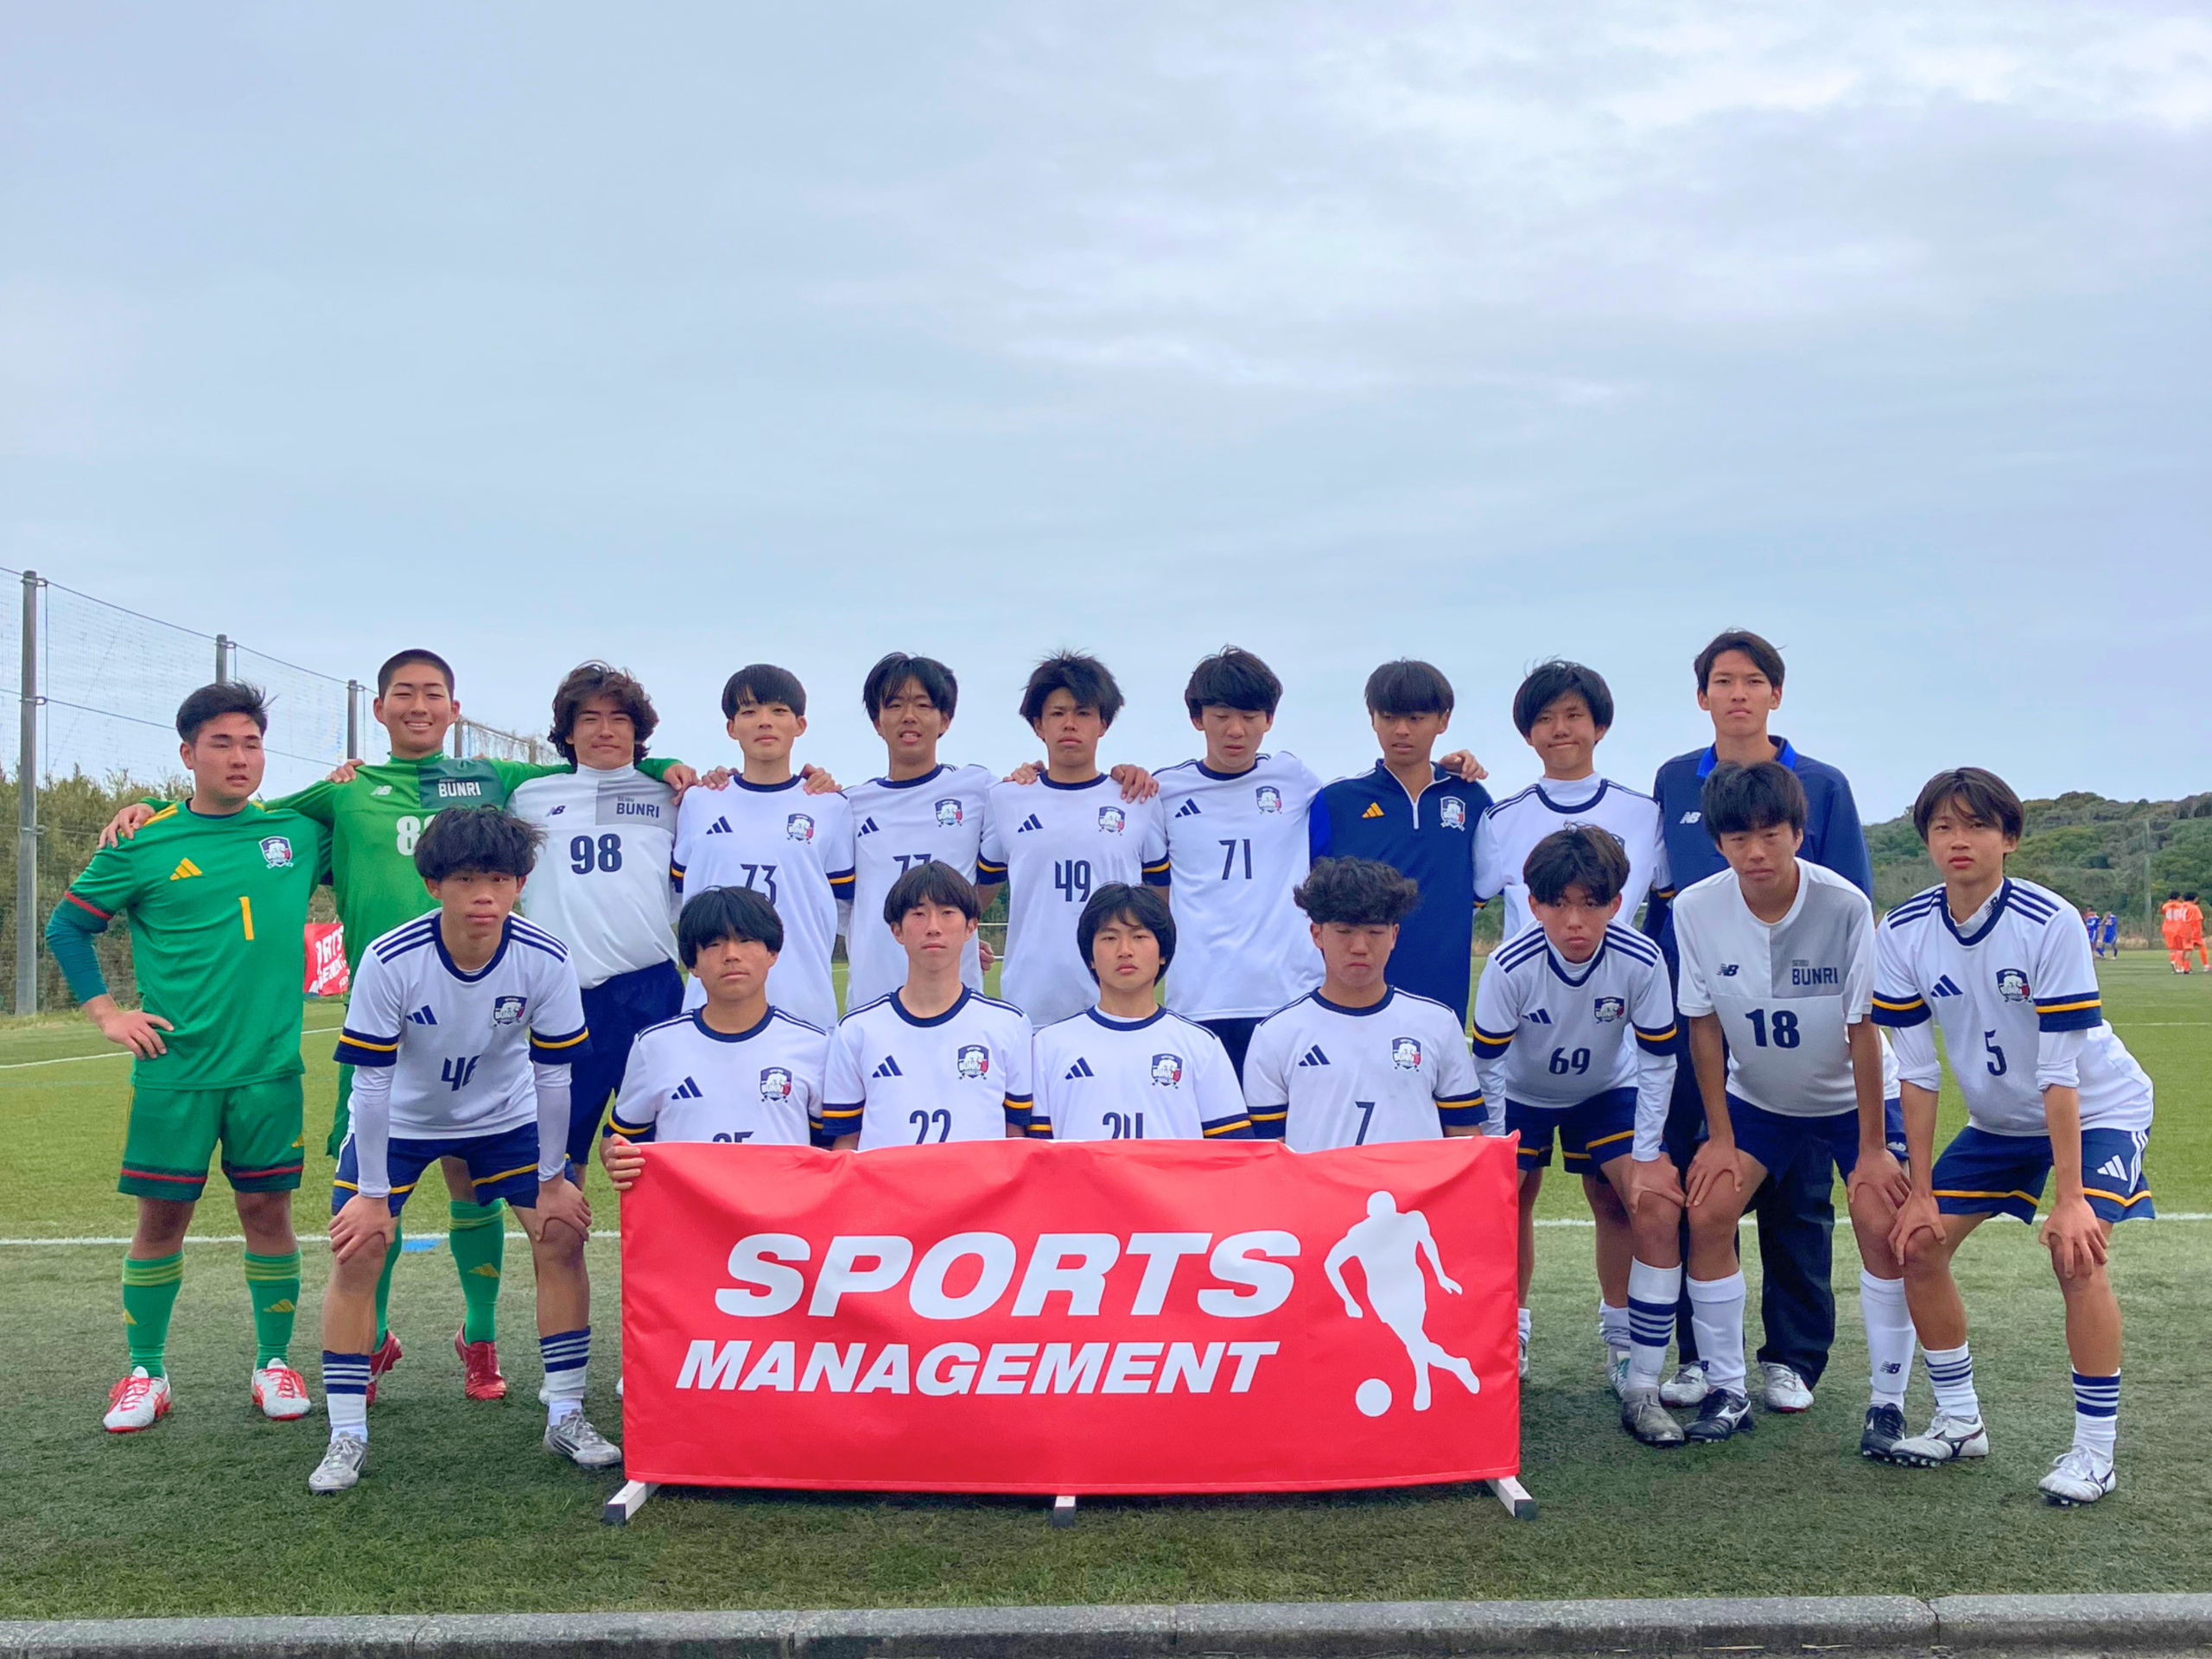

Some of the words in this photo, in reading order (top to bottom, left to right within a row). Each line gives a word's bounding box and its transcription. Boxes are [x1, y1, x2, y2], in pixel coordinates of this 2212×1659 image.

[438, 782, 481, 797] BUNRI
[616, 803, 660, 818] BUNRI
[397, 814, 436, 856] 8
[570, 833, 622, 874] 98
[1218, 838, 1252, 880] 71
[740, 863, 778, 906] 73
[1055, 860, 1091, 902] 49
[238, 896, 255, 941] 1
[1791, 967, 1839, 986] BUNRI
[1745, 1008, 1801, 1049] 18
[1548, 1046, 1591, 1075] 69
[1985, 1029, 2007, 1077] 5
[909, 1109, 952, 1145] 22
[1354, 1101, 1376, 1147] 7
[715, 1230, 1301, 1320] SPORTS
[676, 1339, 1281, 1395] MANAGEMENT
